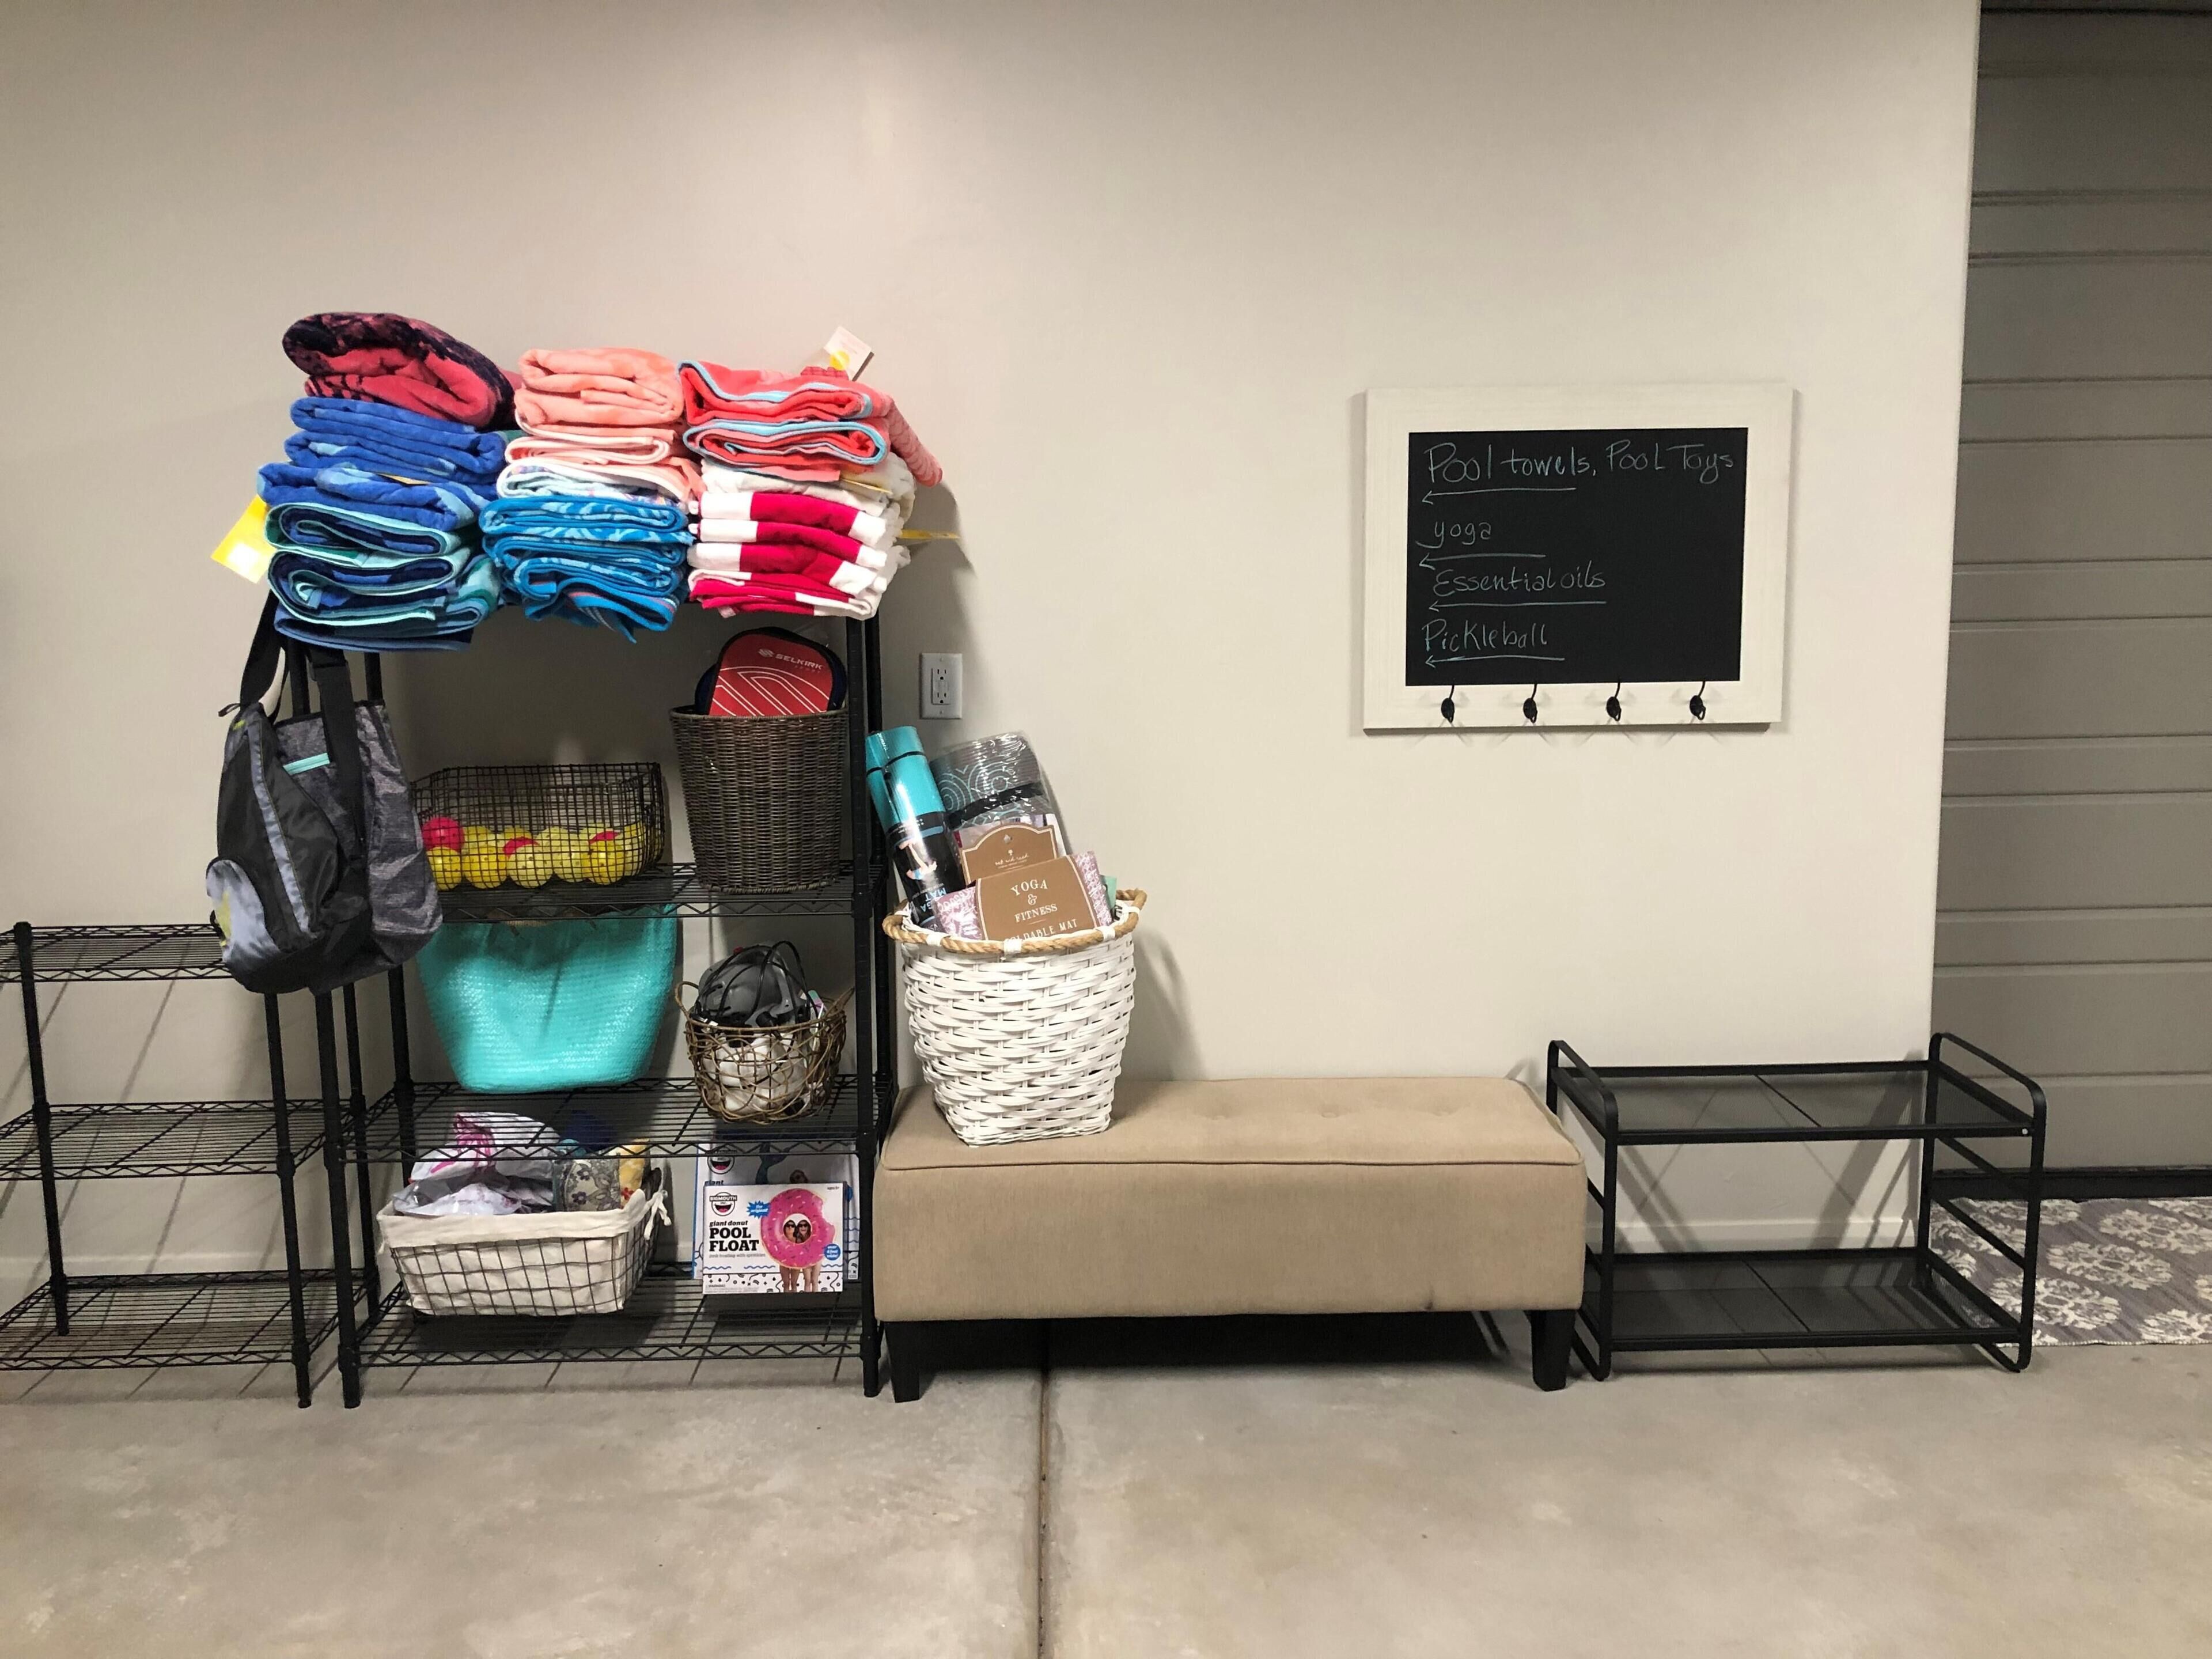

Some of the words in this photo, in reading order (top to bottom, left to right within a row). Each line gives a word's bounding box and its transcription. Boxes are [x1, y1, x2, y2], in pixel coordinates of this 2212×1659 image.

[1423, 442, 1491, 483] Pool
[1501, 446, 1597, 476] towels,
[1666, 444, 1733, 484] Toys
[1415, 520, 1491, 548] yoga
[1432, 565, 1554, 597] Essential
[1560, 559, 1607, 588] oils
[775, 654, 823, 670] SELKIRK
[925, 888, 947, 902] MAT
[1010, 879, 1048, 896] YOGA
[1028, 893, 1037, 906] &
[1014, 903, 1058, 923] FITNESS
[1005, 925, 1056, 941] DABLE
[1059, 918, 1078, 931] MAT
[709, 1227, 751, 1239] POOL
[709, 1240, 759, 1252] FLOAT
